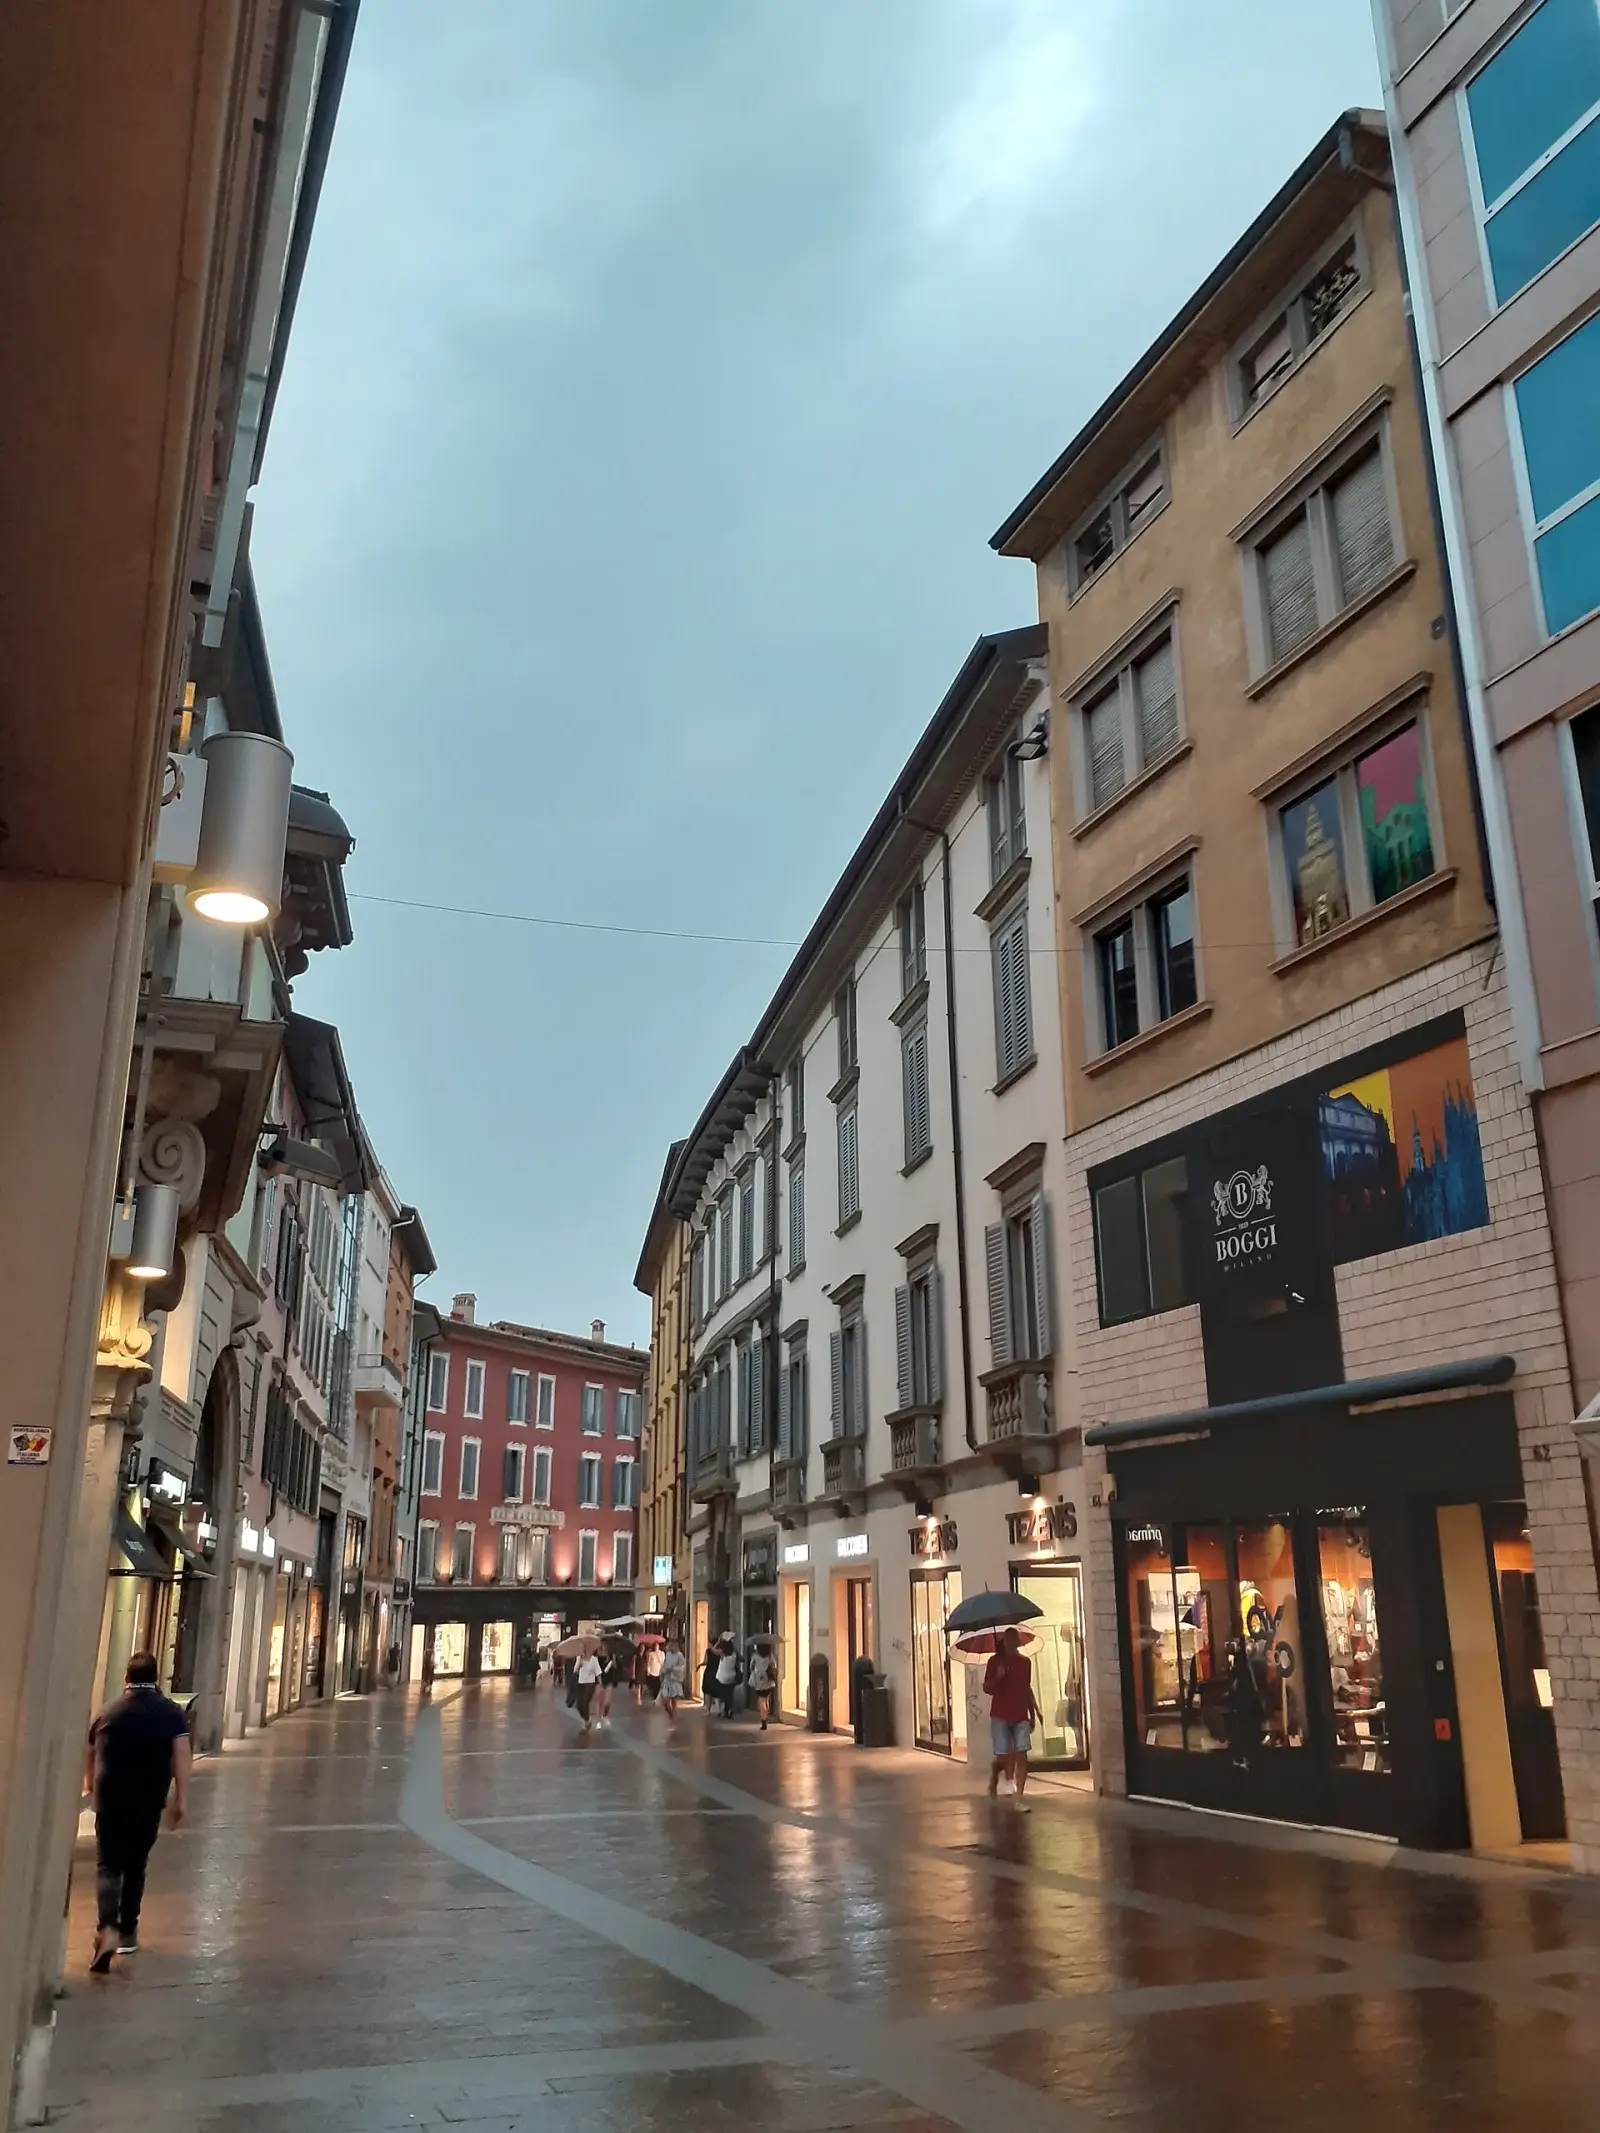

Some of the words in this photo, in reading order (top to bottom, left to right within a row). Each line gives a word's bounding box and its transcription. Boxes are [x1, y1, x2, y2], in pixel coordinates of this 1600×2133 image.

[1234, 1182, 1248, 1206] B
[1215, 1224, 1278, 1262] BOGGI
[1223, 1253, 1272, 1272] MILANO
[908, 1513, 958, 1555] TEZENIS
[1005, 1495, 1078, 1545] TEZENIS
